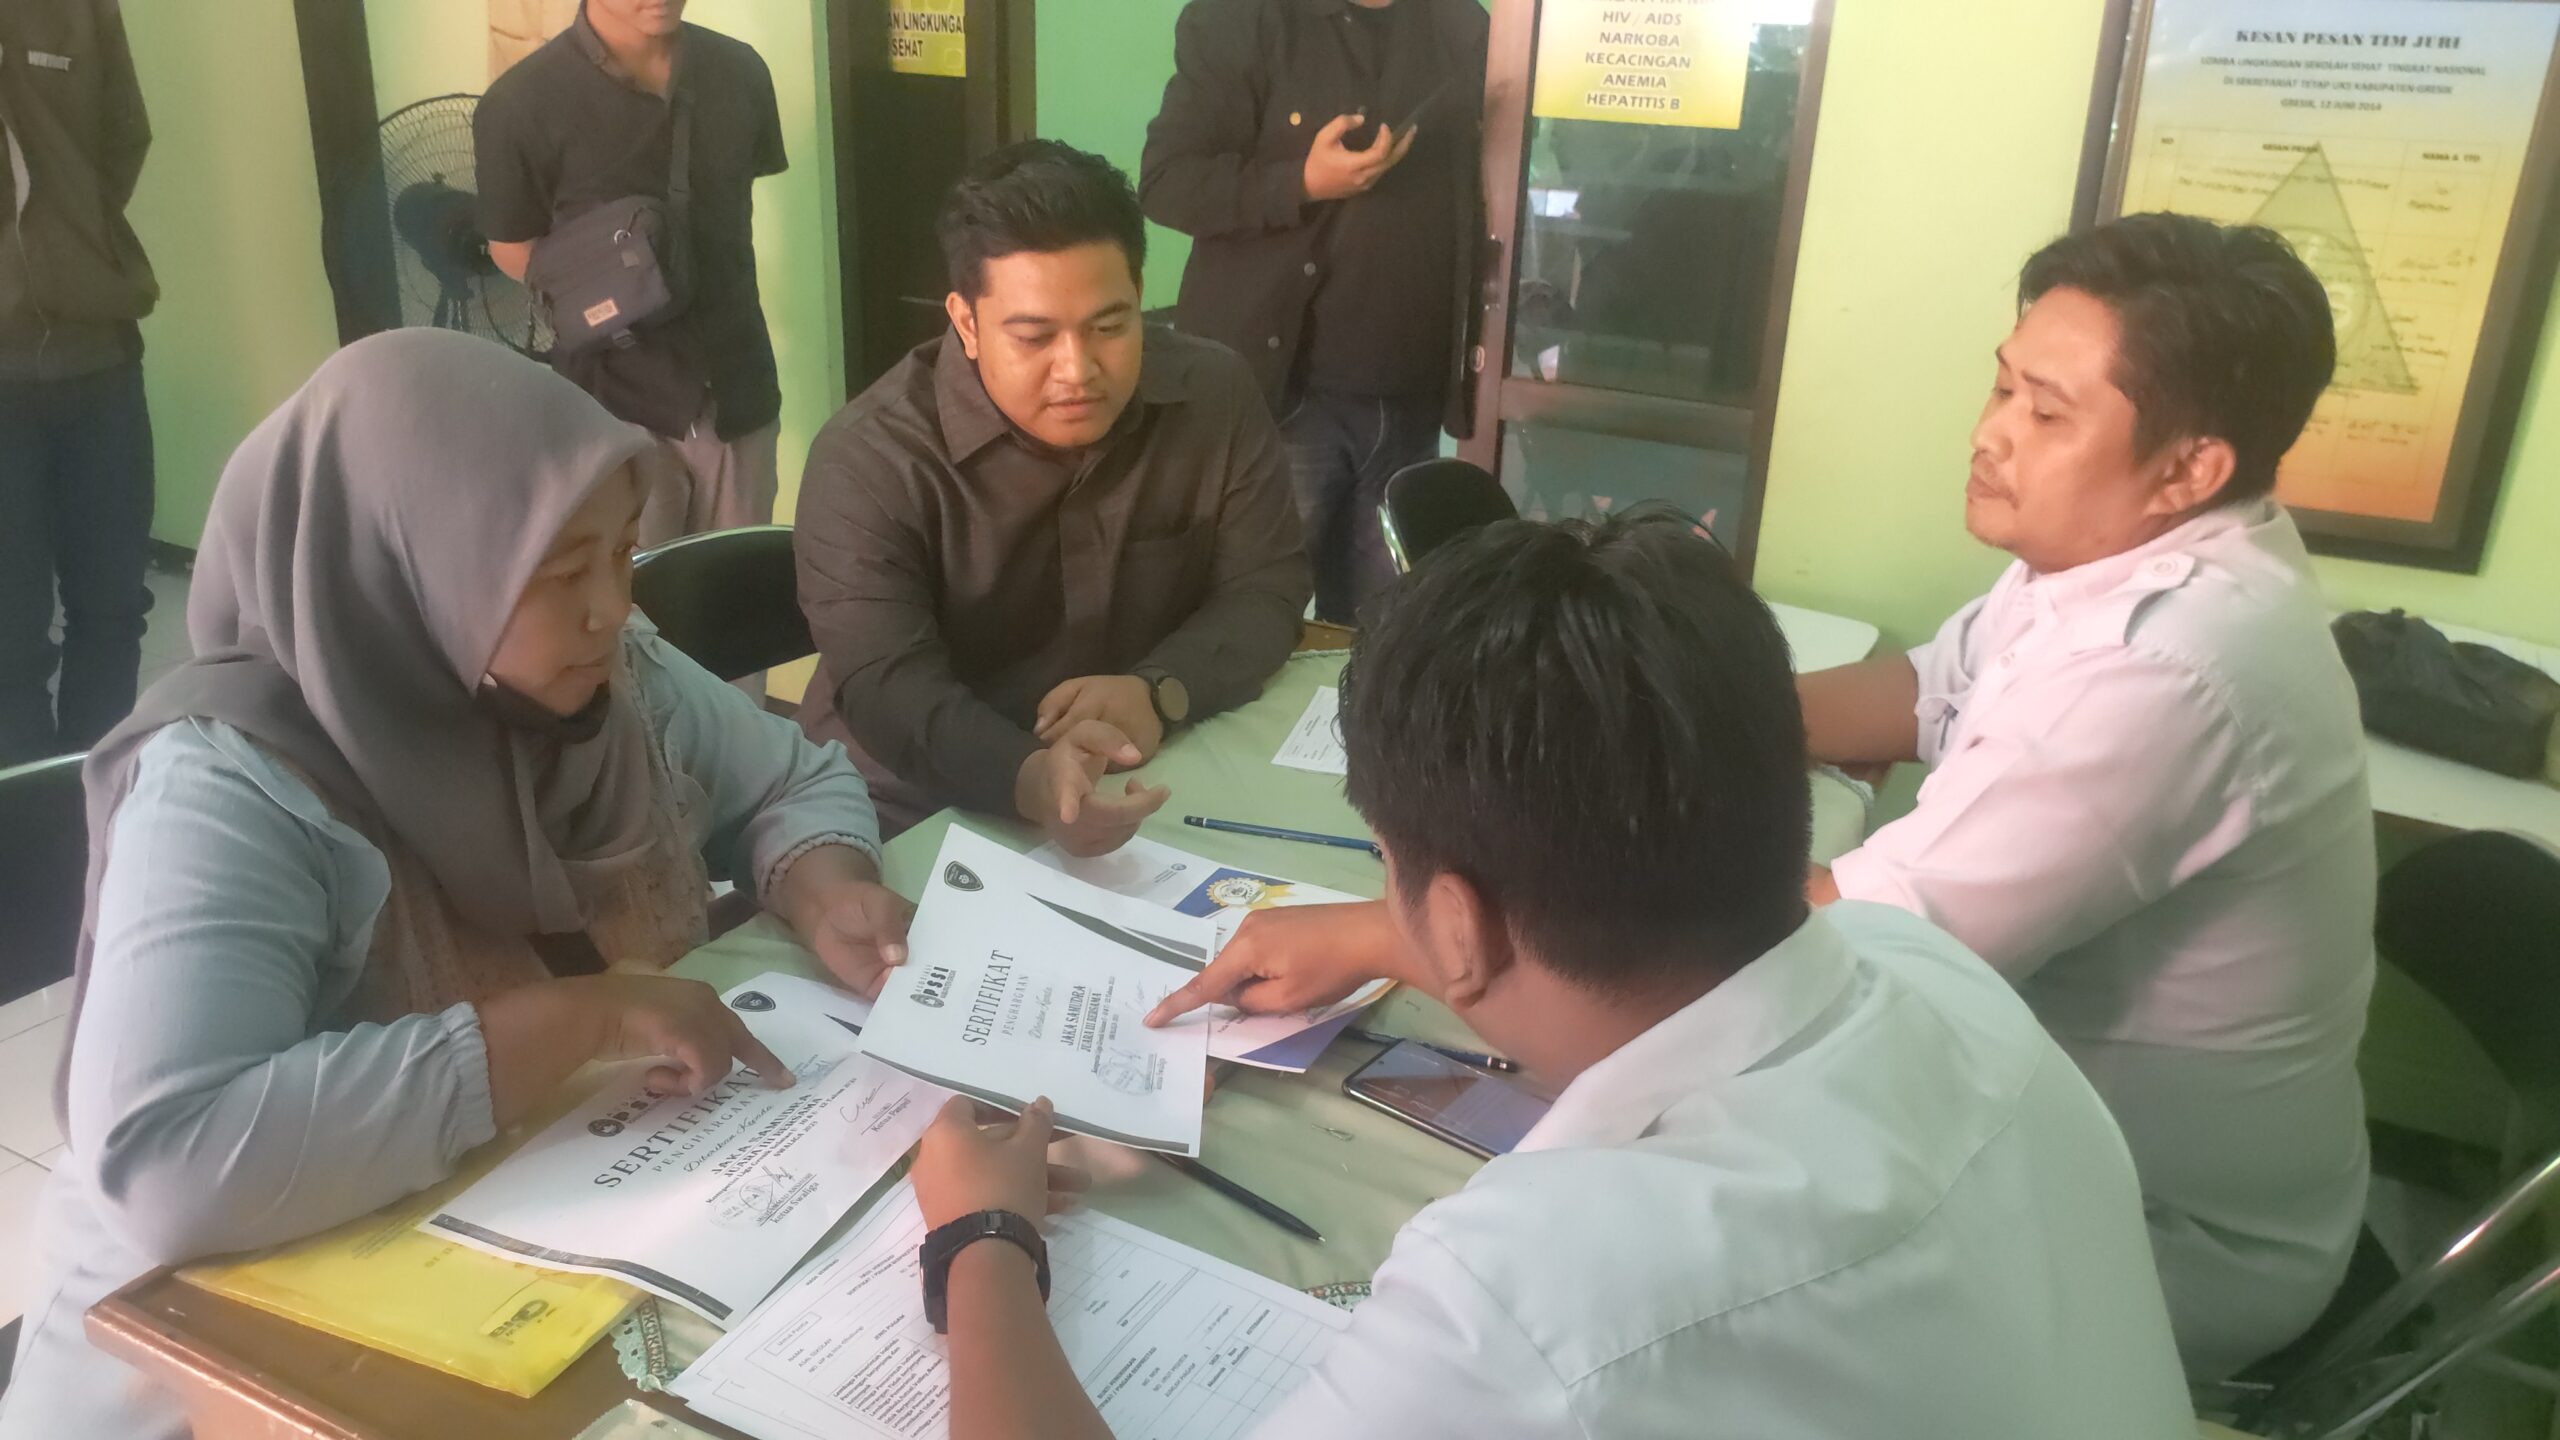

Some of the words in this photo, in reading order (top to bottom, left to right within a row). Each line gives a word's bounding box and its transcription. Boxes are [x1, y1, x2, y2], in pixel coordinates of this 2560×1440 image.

[903, 12, 967, 33] LINGKUNGA
[1602, 10, 1631, 24] HIV
[1644, 12, 1682, 26] AIDS
[892, 39, 923, 57] SEHAT
[1599, 32, 1680, 47] NARKOBA
[2236, 30, 2298, 44] KESAN
[2303, 32, 2365, 45] PESAN
[2370, 34, 2407, 47] TIM
[2412, 35, 2461, 49] JURI
[1585, 52, 1691, 69] KECACINGAN
[1603, 73, 1667, 88] ANEMIA
[1586, 93, 1665, 110] HEPATITIS
[1670, 98, 1680, 110] B
[923, 966, 948, 996] PSSI
[961, 948, 1013, 1046] SERTIFIKAT
[1001, 974, 1028, 1035] PENGHARGAAN
[1065, 985, 1085, 1022] SAMUDRA
[1086, 992, 1101, 1022] BERSAMA
[1060, 1023, 1077, 1045] JAKA
[1080, 1030, 1094, 1052] JUARA
[592, 1066, 761, 1188] SERTIFIKAT
[651, 1091, 761, 1173] PENGHARGAAN
[710, 1143, 750, 1173] JAKA
[747, 1092, 812, 1145] SAMUDRA
[723, 1148, 762, 1178] JUARA
[773, 1097, 823, 1137] BERSAMA
